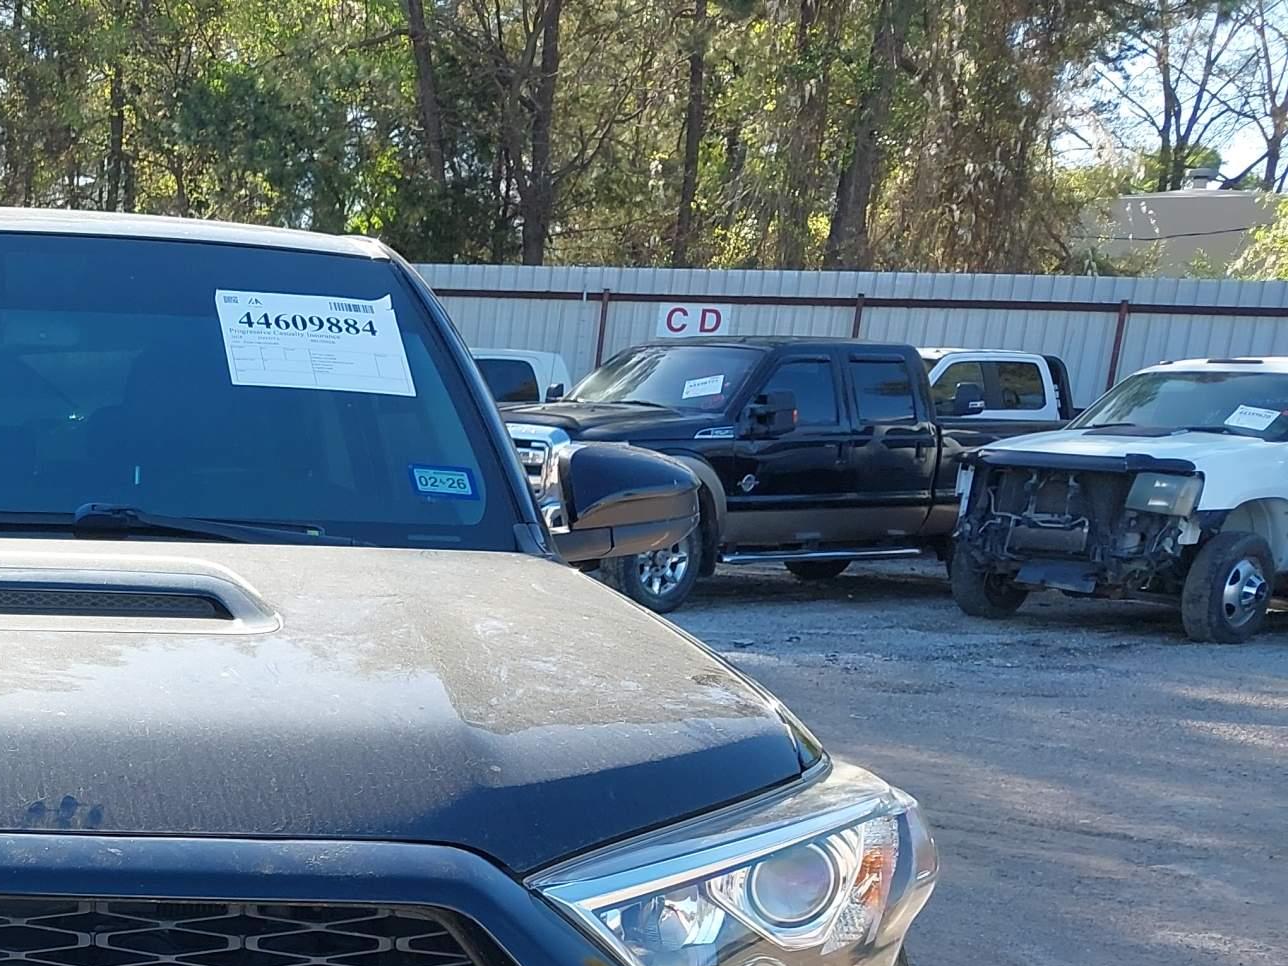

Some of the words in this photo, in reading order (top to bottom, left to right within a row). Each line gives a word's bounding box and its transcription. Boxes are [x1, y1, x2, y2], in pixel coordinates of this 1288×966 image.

[238, 312, 377, 336] 44609884
[666, 307, 688, 332] C
[699, 309, 722, 333] D
